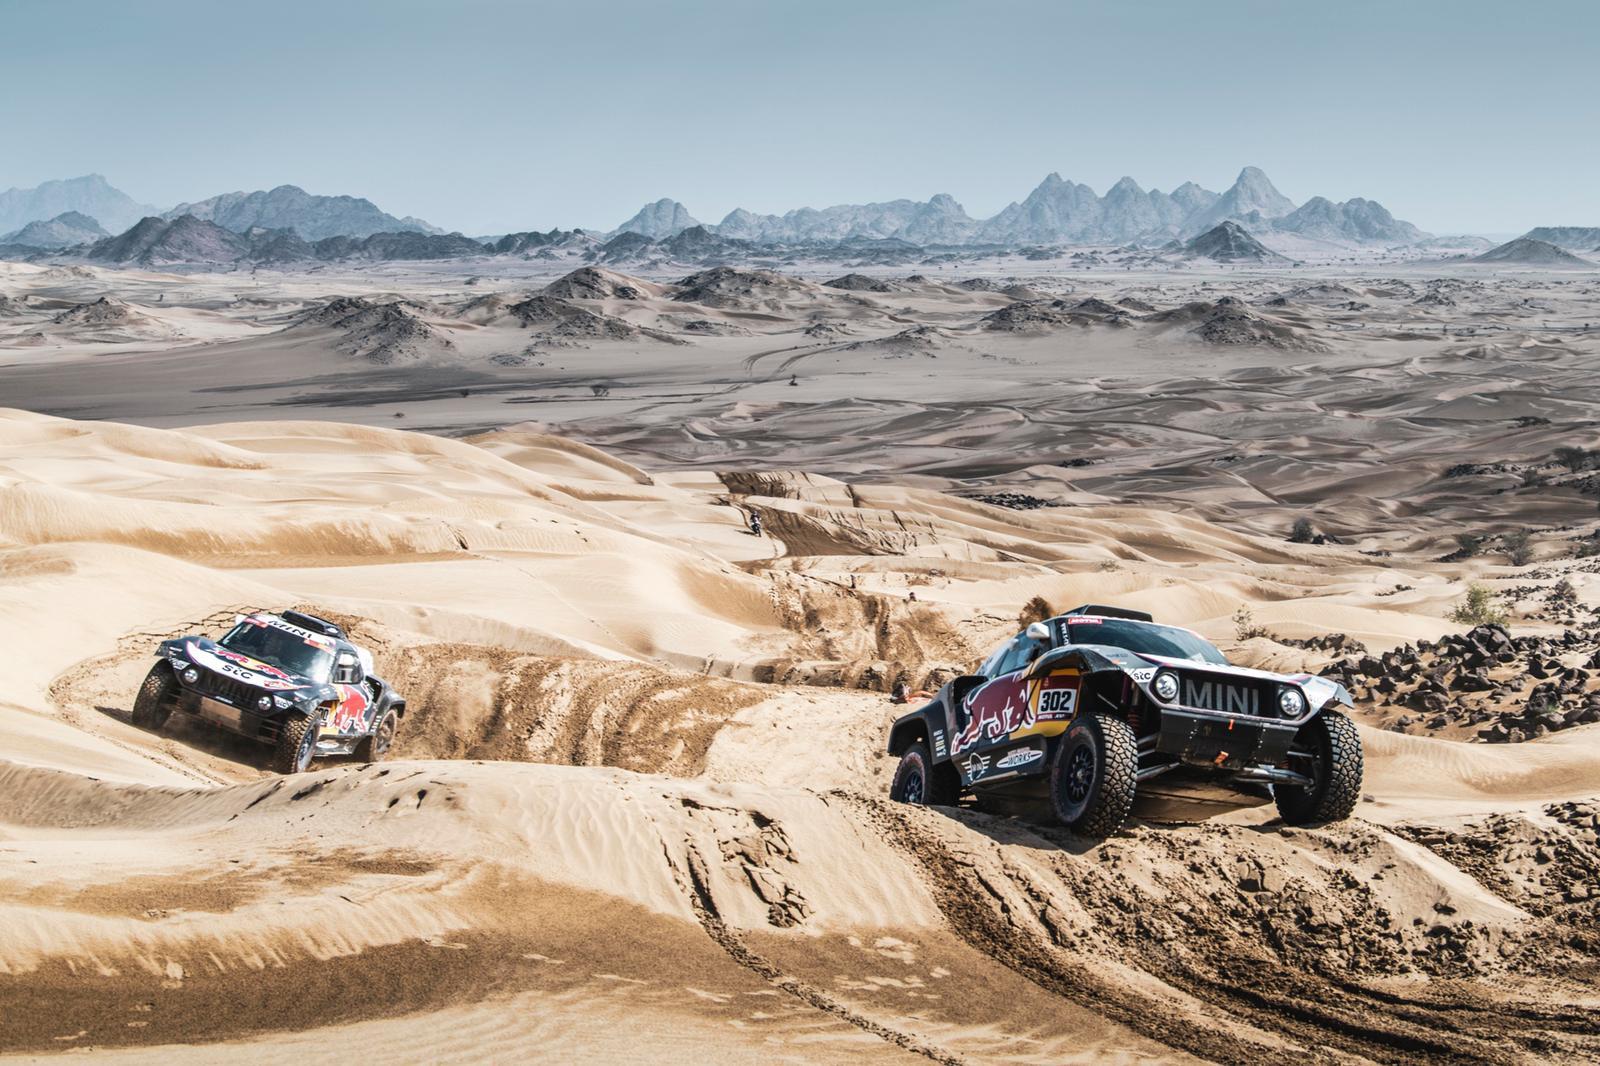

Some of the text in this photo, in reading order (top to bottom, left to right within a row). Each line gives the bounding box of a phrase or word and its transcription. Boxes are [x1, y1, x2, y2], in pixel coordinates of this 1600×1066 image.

[268, 620, 312, 638] MINI
[1040, 690, 1072, 712] 302
[1185, 679, 1259, 715] MINI
[1007, 751, 1031, 766] WORKS
